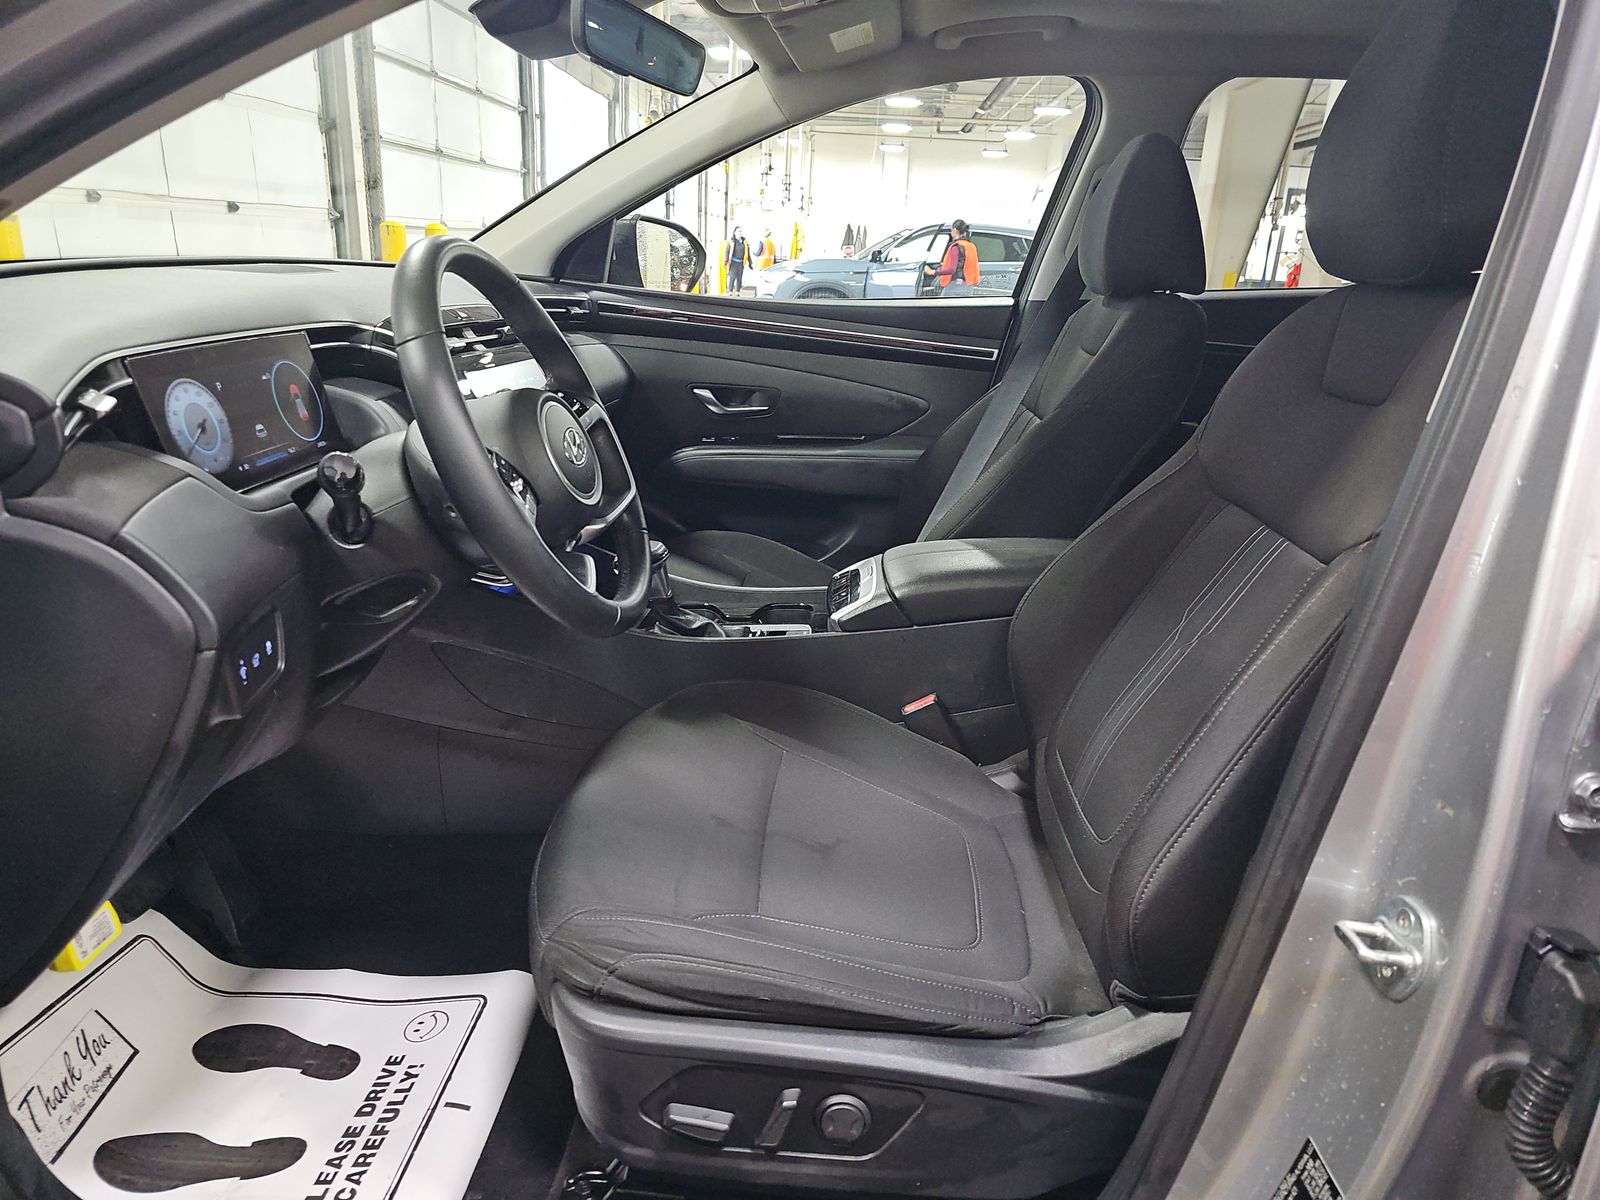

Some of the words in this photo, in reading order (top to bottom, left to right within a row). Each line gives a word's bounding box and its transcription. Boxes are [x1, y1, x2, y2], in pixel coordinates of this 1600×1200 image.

[18, 1051, 82, 1133] Thank
[76, 1028, 111, 1066] You
[304, 1125, 366, 1200] LEASE
[354, 1055, 406, 1117] DRIVE
[334, 1064, 425, 1200] CAREFULLY!
